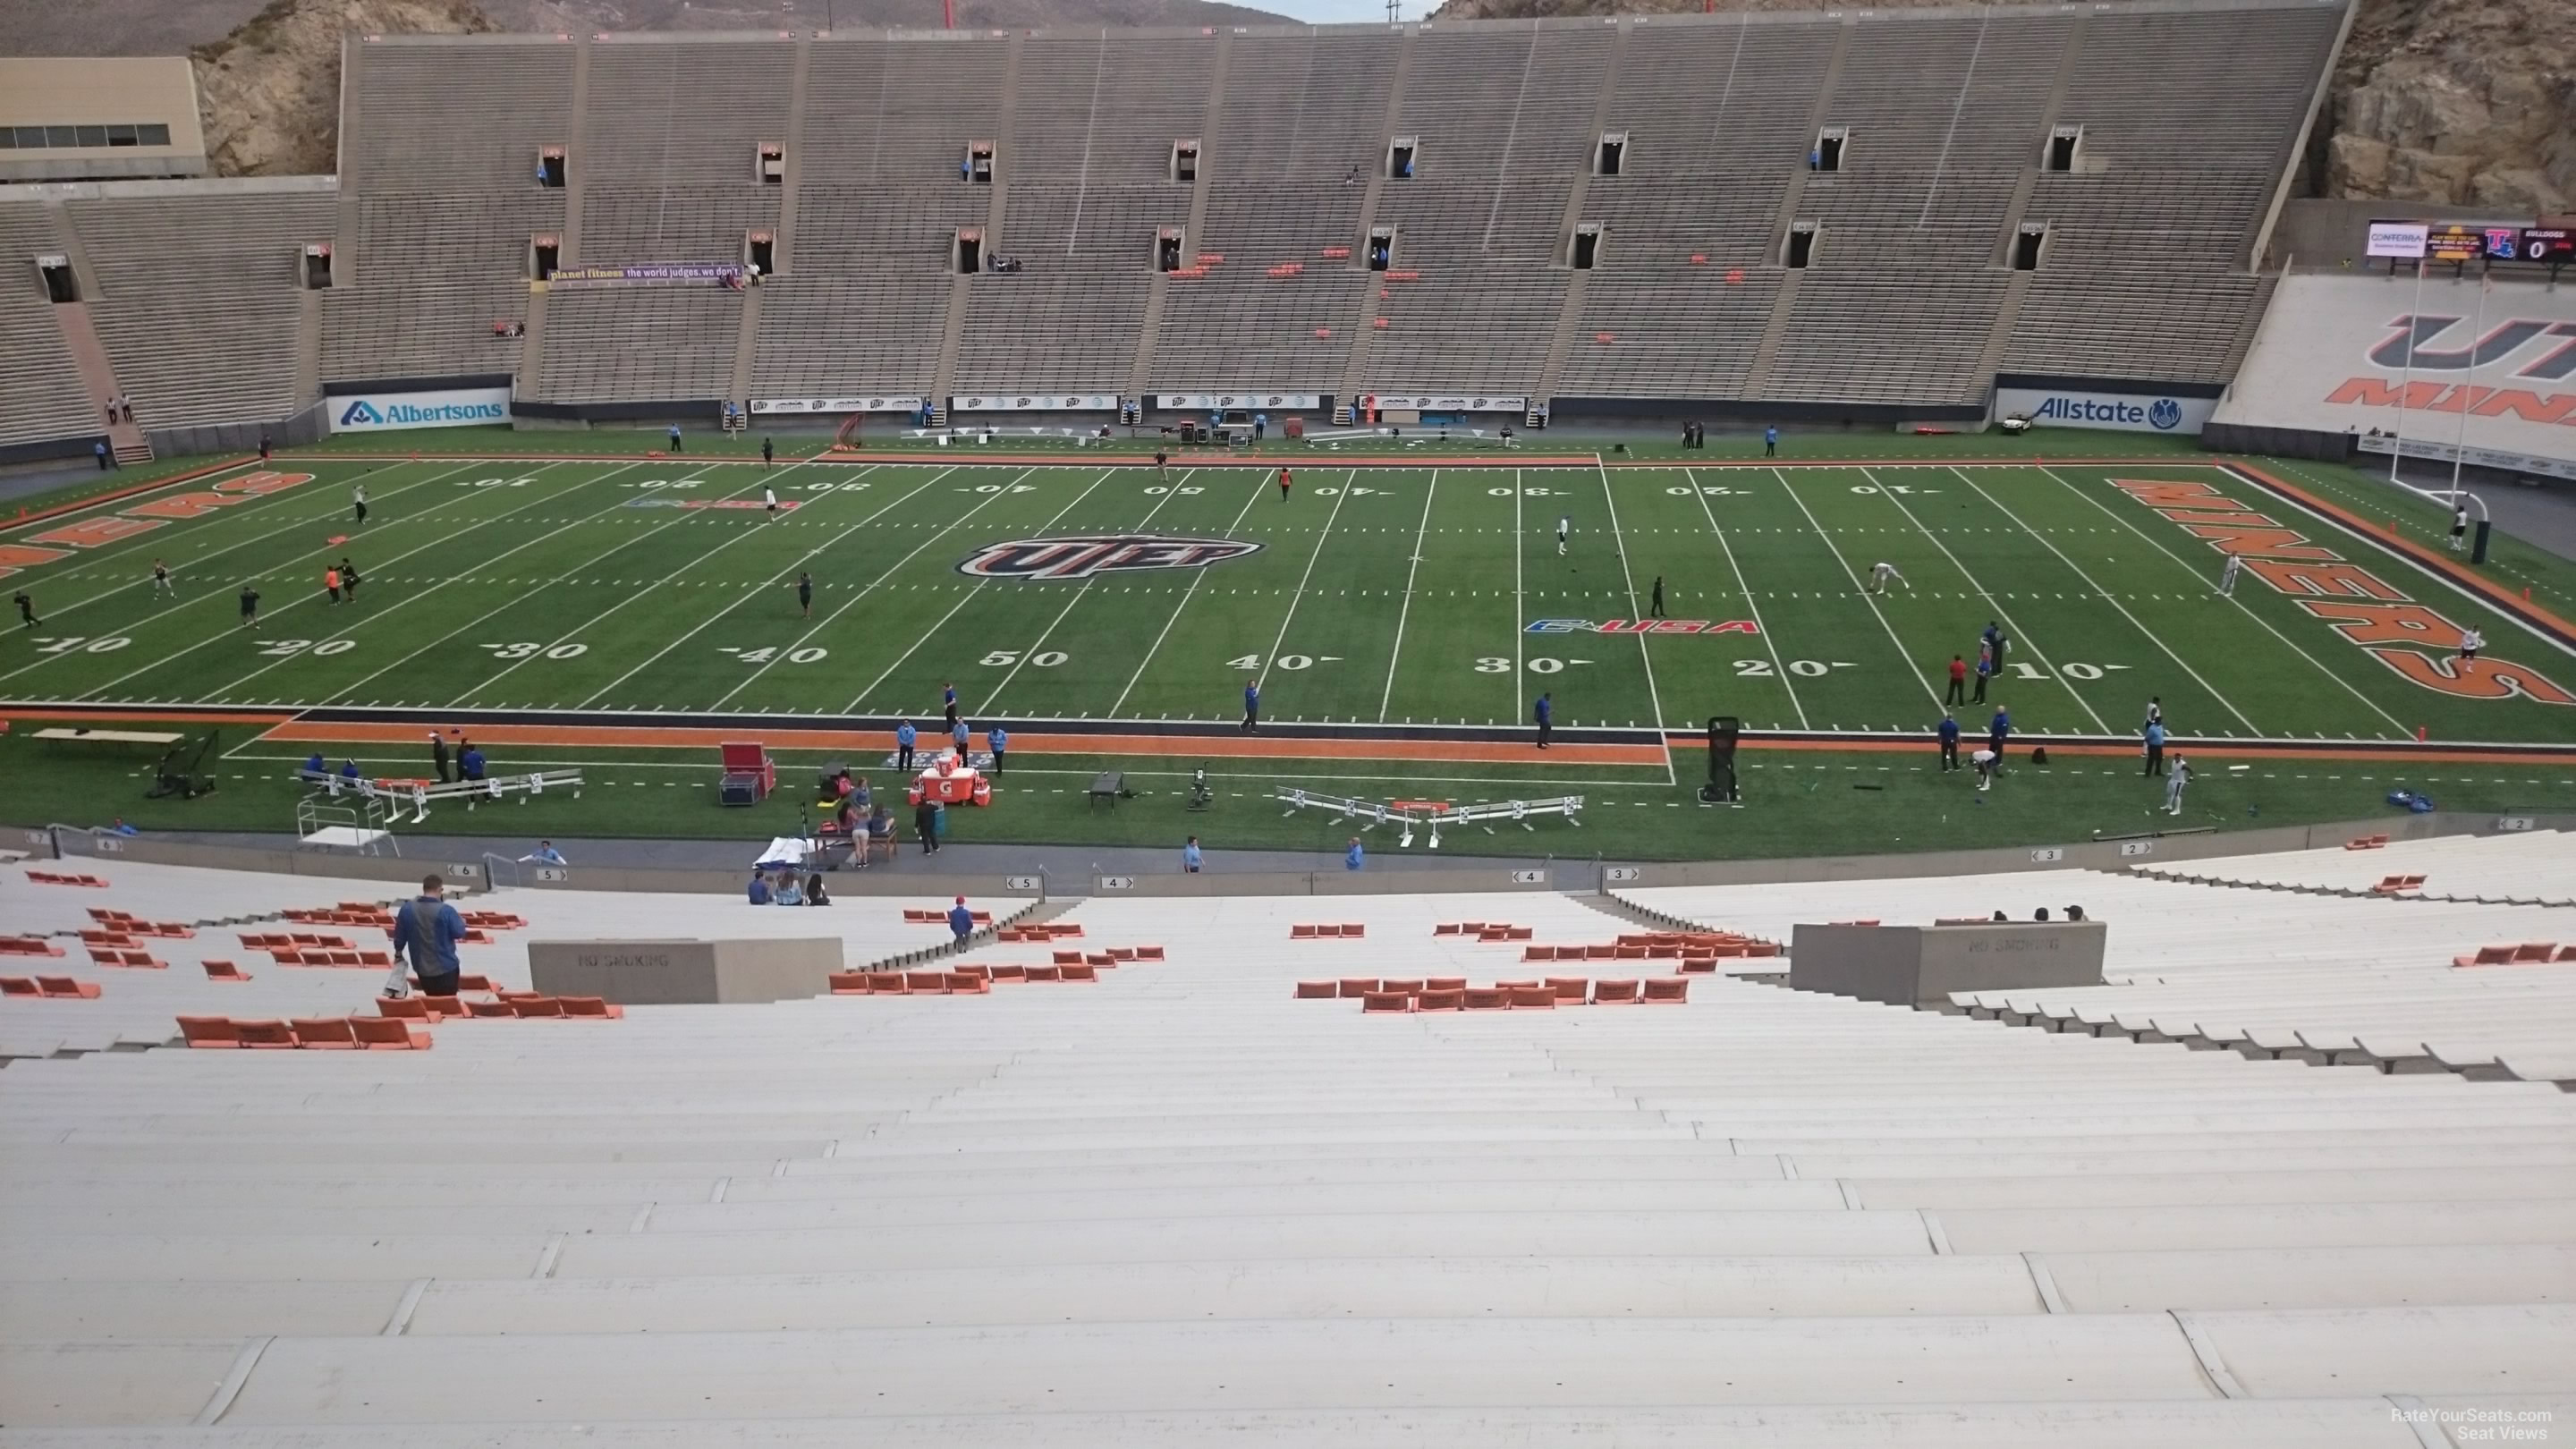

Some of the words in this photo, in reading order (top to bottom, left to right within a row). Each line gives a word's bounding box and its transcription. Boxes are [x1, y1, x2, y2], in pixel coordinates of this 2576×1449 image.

[2530, 242, 2543, 258] 0
[551, 269, 586, 282] planet
[587, 269, 623, 278] fitness
[627, 269, 641, 278] the
[643, 267, 667, 277] world
[716, 267, 741, 276] don't.
[2032, 397, 2144, 423] Allstate
[2323, 377, 2576, 428] MIN
[386, 403, 503, 423] Albertsons
[955, 534, 1267, 580] UTEP
[2104, 479, 2576, 706] MINERS
[38, 638, 131, 654] 10
[261, 640, 356, 656] 20
[497, 643, 588, 659] 30
[736, 647, 827, 663] 40
[979, 651, 1069, 666] 50
[1226, 654, 1313, 670] 40
[1475, 657, 1563, 674] 30
[1733, 660, 1828, 676] 20
[2007, 662, 2104, 680] 10
[939, 781, 952, 793] G
[2515, 819, 2523, 829] 2
[38, 833, 44, 843] 7
[103, 842, 109, 850] 6
[2129, 844, 2136, 853] 2
[2046, 850, 2054, 860] 3
[462, 866, 470, 875] 6
[545, 870, 551, 878] 5
[1526, 872, 1535, 881] 4
[1614, 869, 1622, 878] 3
[1023, 878, 1030, 888] 5
[1108, 878, 1117, 887] 4
[578, 955, 597, 967] NO
[604, 955, 668, 967] SMOKING
